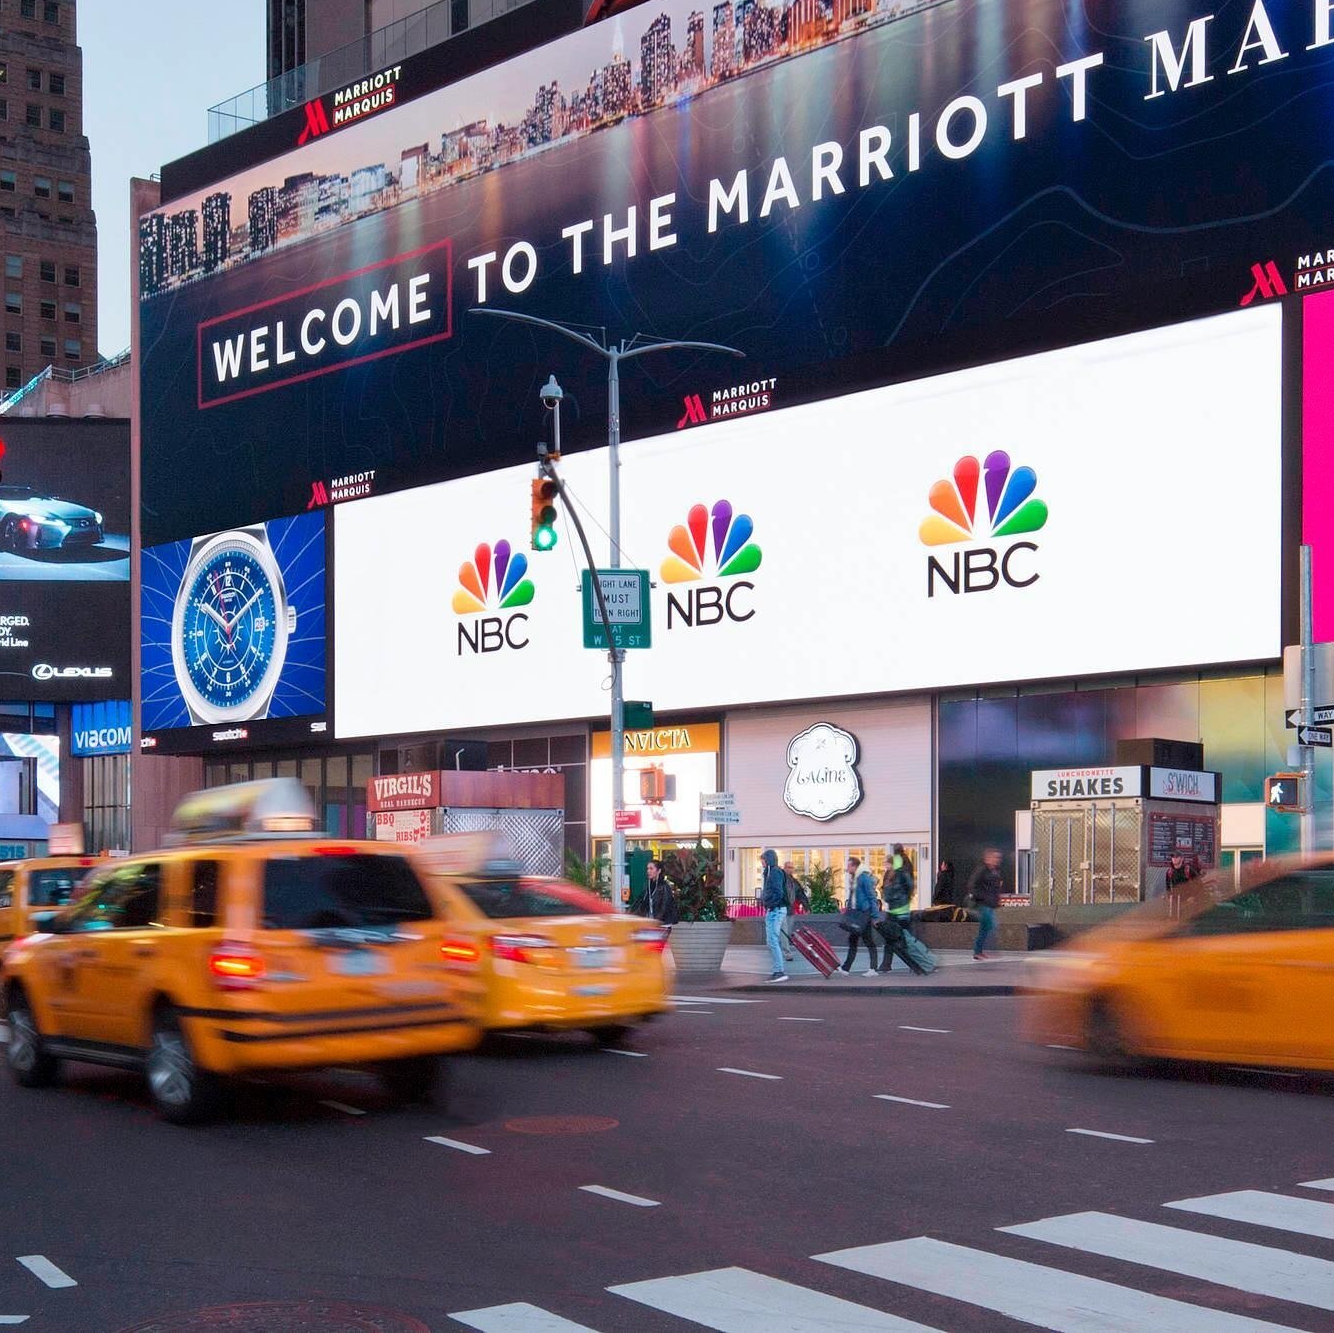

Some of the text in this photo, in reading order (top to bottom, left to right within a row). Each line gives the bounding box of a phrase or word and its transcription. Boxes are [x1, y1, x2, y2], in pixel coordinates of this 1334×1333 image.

[334, 66, 402, 107] MARRIOTT
[334, 87, 395, 124] MARQUIS
[212, 272, 432, 382] WELCOME
[468, 240, 537, 304] TO
[563, 193, 676, 275] THE
[708, 53, 1104, 234] MARRIOTT
[712, 377, 777, 402] MARRIOTT
[712, 395, 769, 417] MARQUIS
[331, 471, 376, 488] MARRIOTT
[331, 484, 370, 501] MARQUIS
[928, 541, 1040, 599] NBC
[618, 580, 637, 589] LANE
[603, 593, 630, 604] MUST
[667, 581, 756, 631] NBC
[617, 609, 640, 618] RIGHT
[458, 613, 530, 656] NBC
[611, 626, 623, 634] AT
[10, 637, 29, 647] Line
[594, 636, 641, 645] W ST
[53, 667, 113, 678] LEXUS
[1317, 711, 1333, 720] WAY
[624, 729, 691, 752] NVICTA
[1057, 769, 1115, 777] LUNCHEONETTE
[374, 773, 432, 801] VIRGIL'S
[1048, 777, 1124, 797] SHAKES
[380, 800, 395, 808] REAL
[376, 813, 395, 826] BBQ
[395, 831, 413, 842] RIBS
